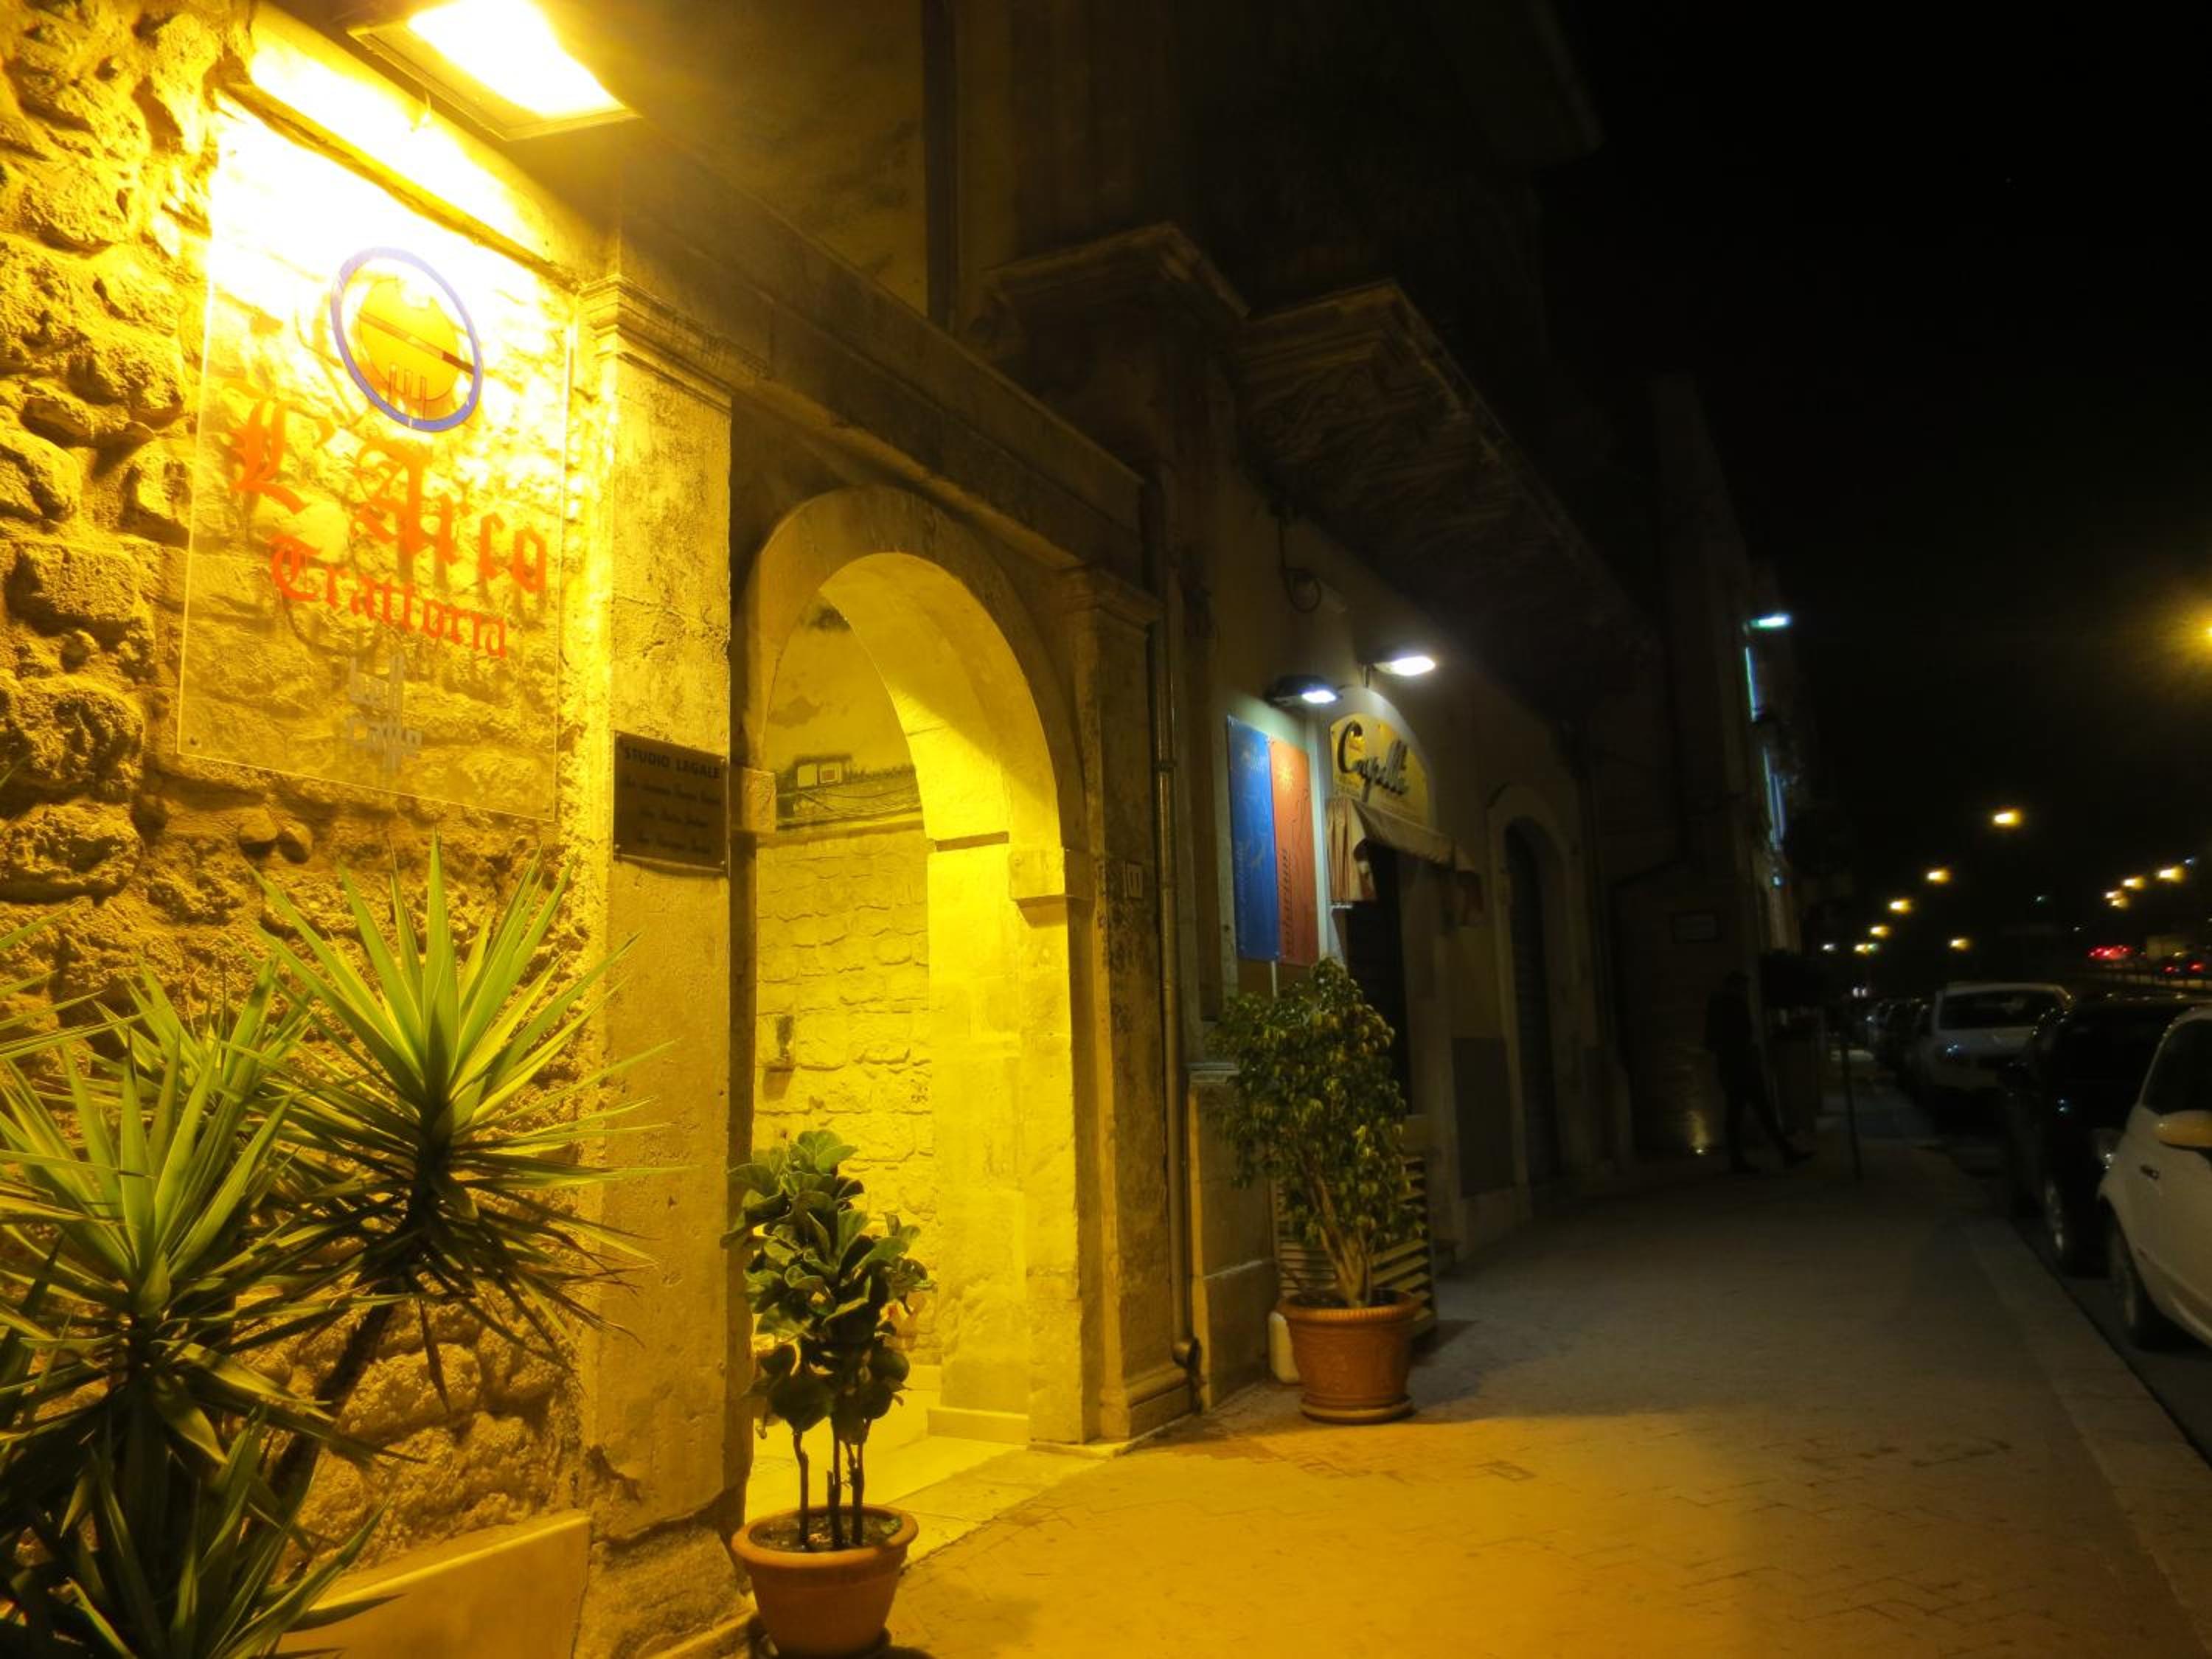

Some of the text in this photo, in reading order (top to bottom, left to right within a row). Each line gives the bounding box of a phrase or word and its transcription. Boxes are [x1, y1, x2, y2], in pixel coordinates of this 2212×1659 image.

[267, 532, 507, 659] Trattoria
[625, 746, 720, 779] STUDIO LEGALE
